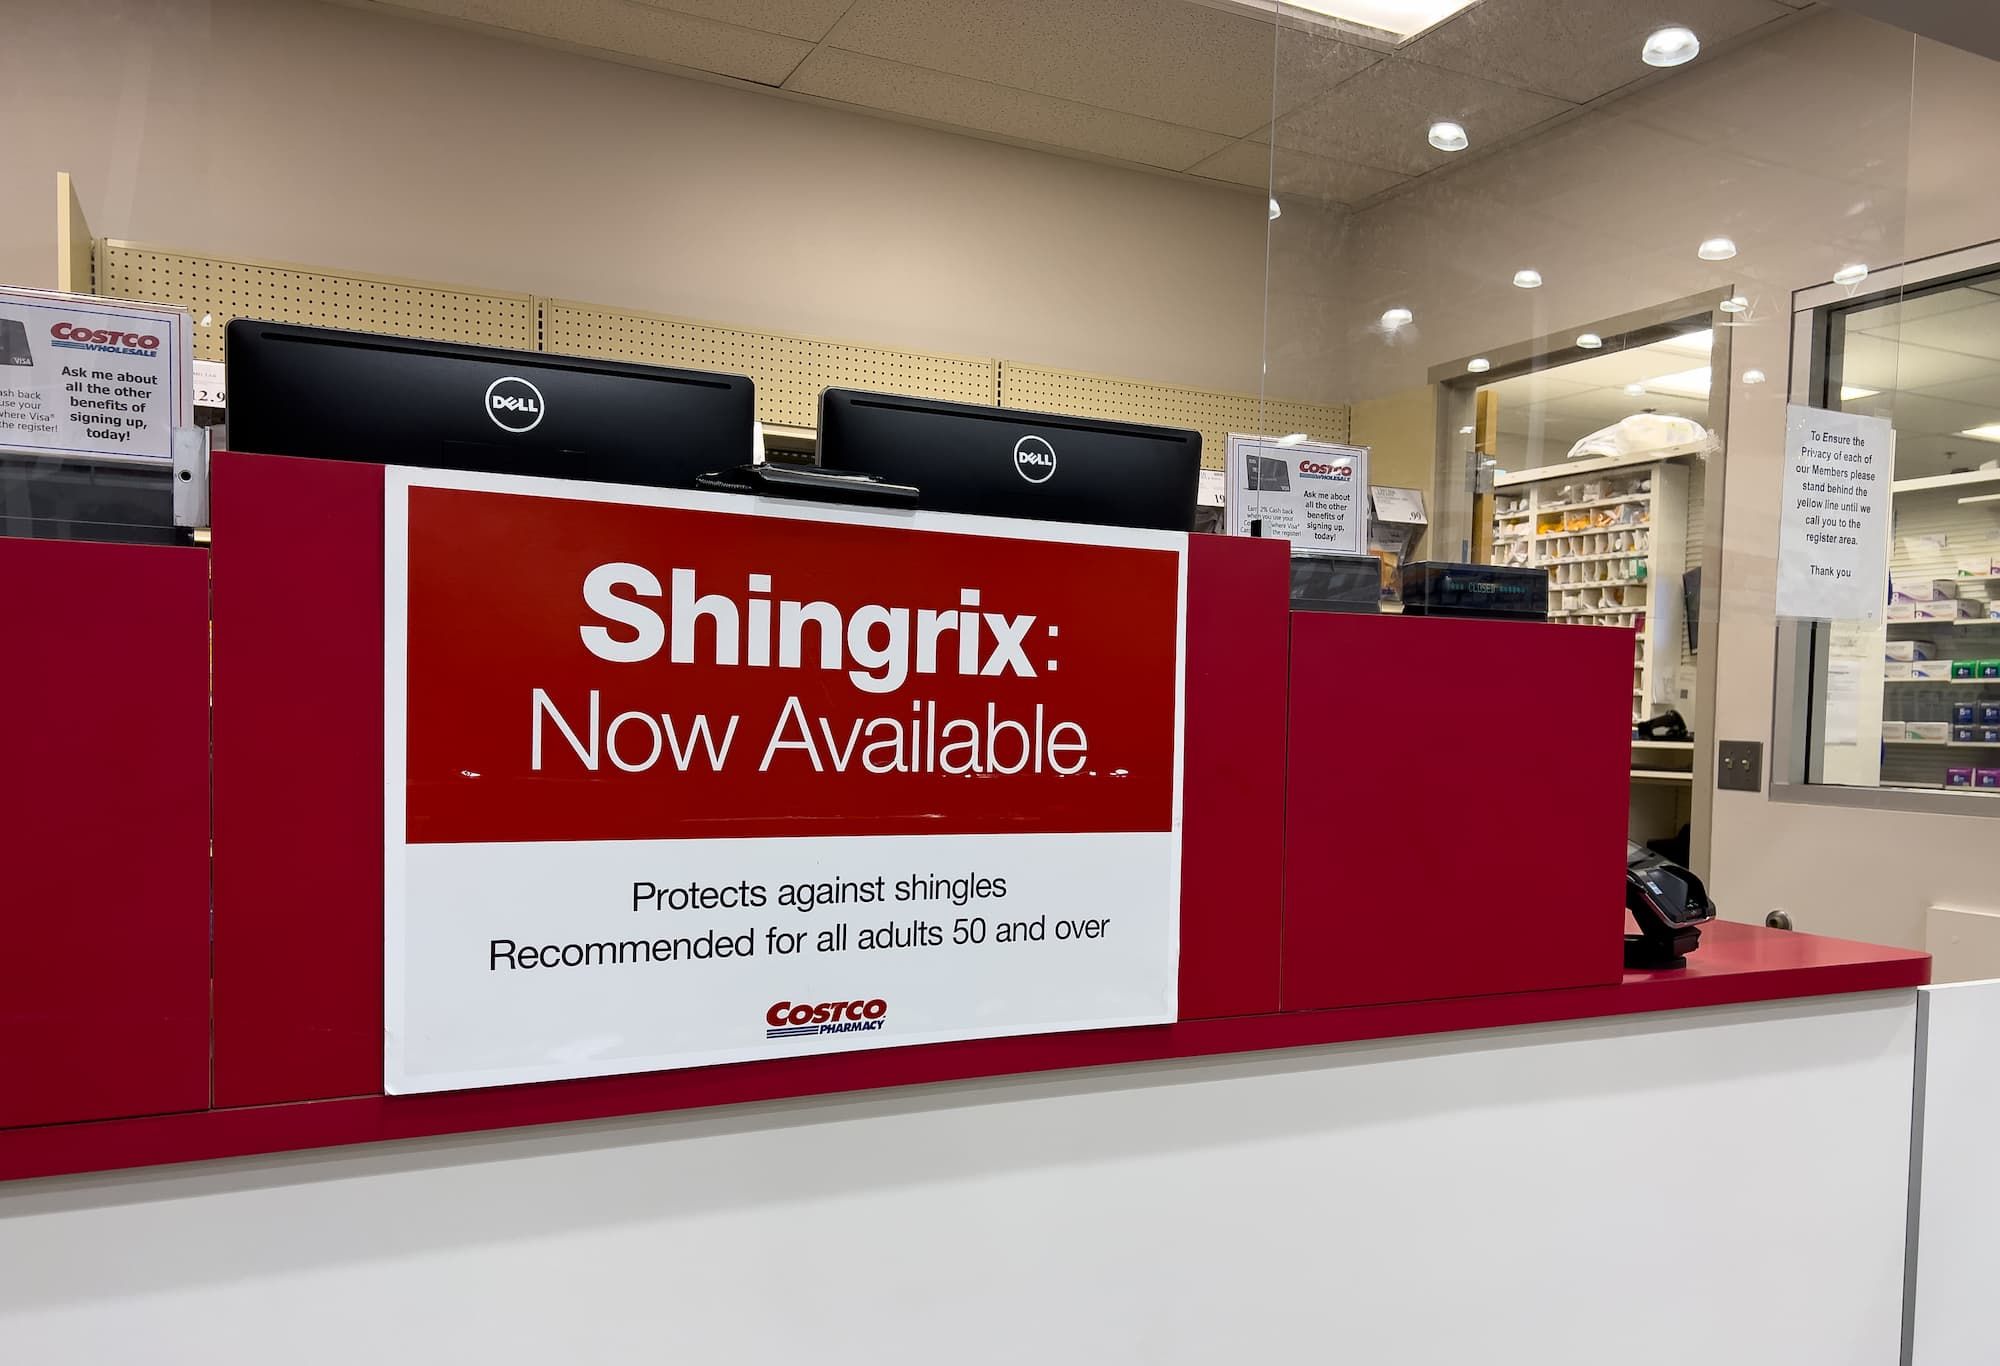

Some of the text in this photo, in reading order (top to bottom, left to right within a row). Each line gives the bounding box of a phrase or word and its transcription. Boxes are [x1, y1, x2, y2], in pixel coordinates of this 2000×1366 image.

[50, 322, 160, 349] COSTCO
[85, 344, 156, 358] WHOLESALE
[62, 366, 158, 385] Ask me about
[18, 390, 40, 400] back
[66, 382, 152, 399] all the other
[18, 402, 41, 410] your
[70, 397, 146, 413] benefits of
[492, 395, 538, 412] DELL
[18, 423, 58, 432] register!
[70, 412, 148, 430] signing up,
[87, 428, 130, 442] today!
[1811, 430, 1864, 446] To Ensure the
[1018, 452, 1052, 466] DELL
[1802, 446, 1872, 464] Privacy of each of
[1796, 464, 1876, 481] our Members please
[1304, 490, 1316, 498] Ask
[1330, 492, 1350, 501] about
[1802, 482, 1868, 496] stand behind the
[1315, 502, 1327, 510] the
[1328, 503, 1348, 511] other
[1797, 498, 1871, 514] yellow line until we
[1307, 512, 1335, 520] benefits
[1805, 515, 1861, 528] call you to the
[1307, 521, 1345, 532] signing up,
[1314, 532, 1336, 542] today!
[1806, 532, 1858, 545] register area.
[1810, 565, 1852, 578] Thank you
[1468, 582, 1496, 594] CLOSED
[580, 562, 1058, 694] Shingrix:
[532, 688, 1088, 774] Now Available
[633, 872, 1007, 912] Protects against shingles
[490, 915, 1110, 970] Recommended for all adults 50 and over
[766, 999, 887, 1026] COSTCO
[820, 1020, 885, 1034] PHARMACY
